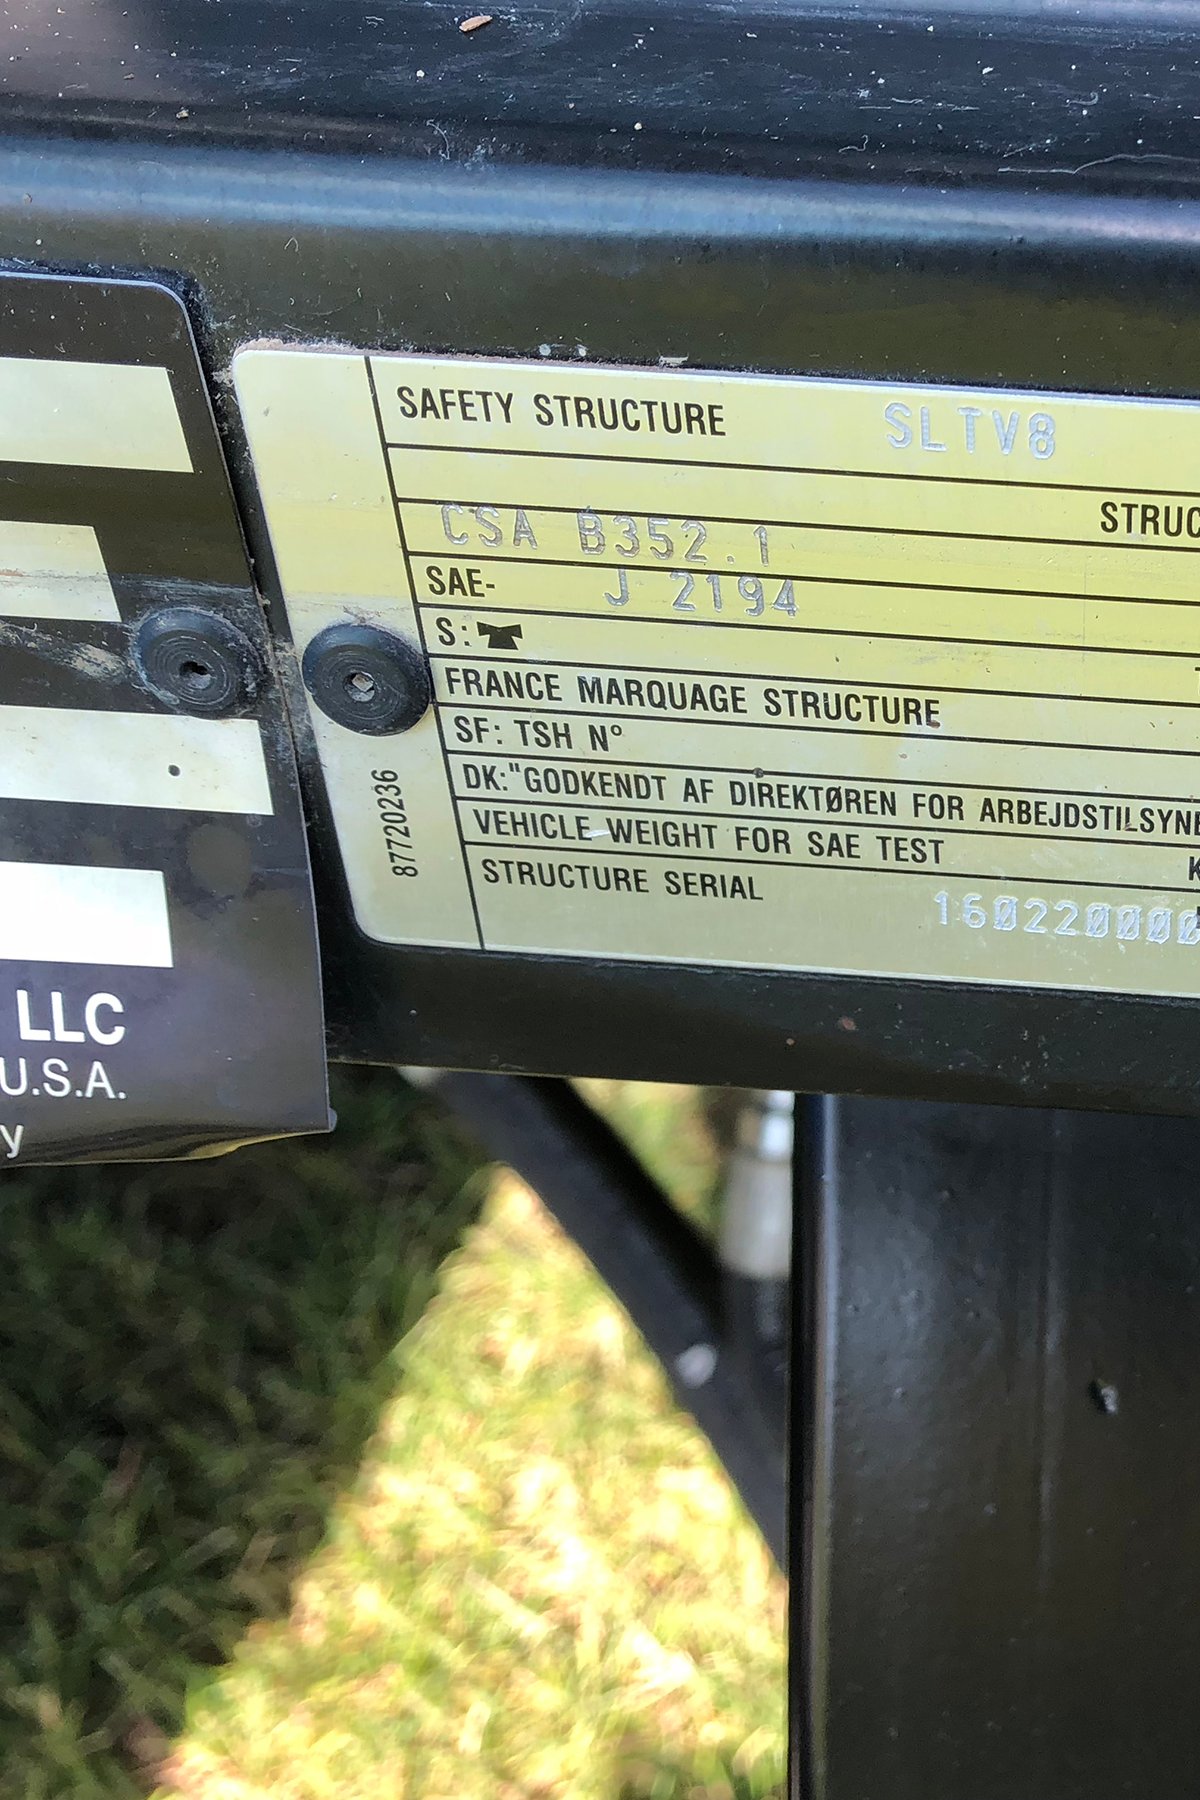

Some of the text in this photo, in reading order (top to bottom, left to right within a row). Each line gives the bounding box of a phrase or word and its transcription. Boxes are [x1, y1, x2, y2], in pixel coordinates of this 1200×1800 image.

[396, 385, 727, 437] SAFETY STRUCTURE
[883, 401, 1057, 460] SLTV8
[440, 502, 540, 550] CSA
[427, 565, 799, 618] SAE- J 2194
[444, 666, 941, 727] FRANCE MARQUAGE STRUCTURE
[455, 715, 624, 752] SF: TSH N°
[370, 767, 420, 879] 87720236
[683, 777, 715, 805] AF
[730, 782, 898, 818] DIREKTØREN
[912, 792, 966, 822] FOR
[472, 808, 946, 865] VEHICLE WEIGHT FOR SAE TEST
[482, 858, 764, 901] STRUCTURE SERIAL
[16, 988, 127, 1046] LLC
[0, 1056, 128, 1100] U.S.A.
